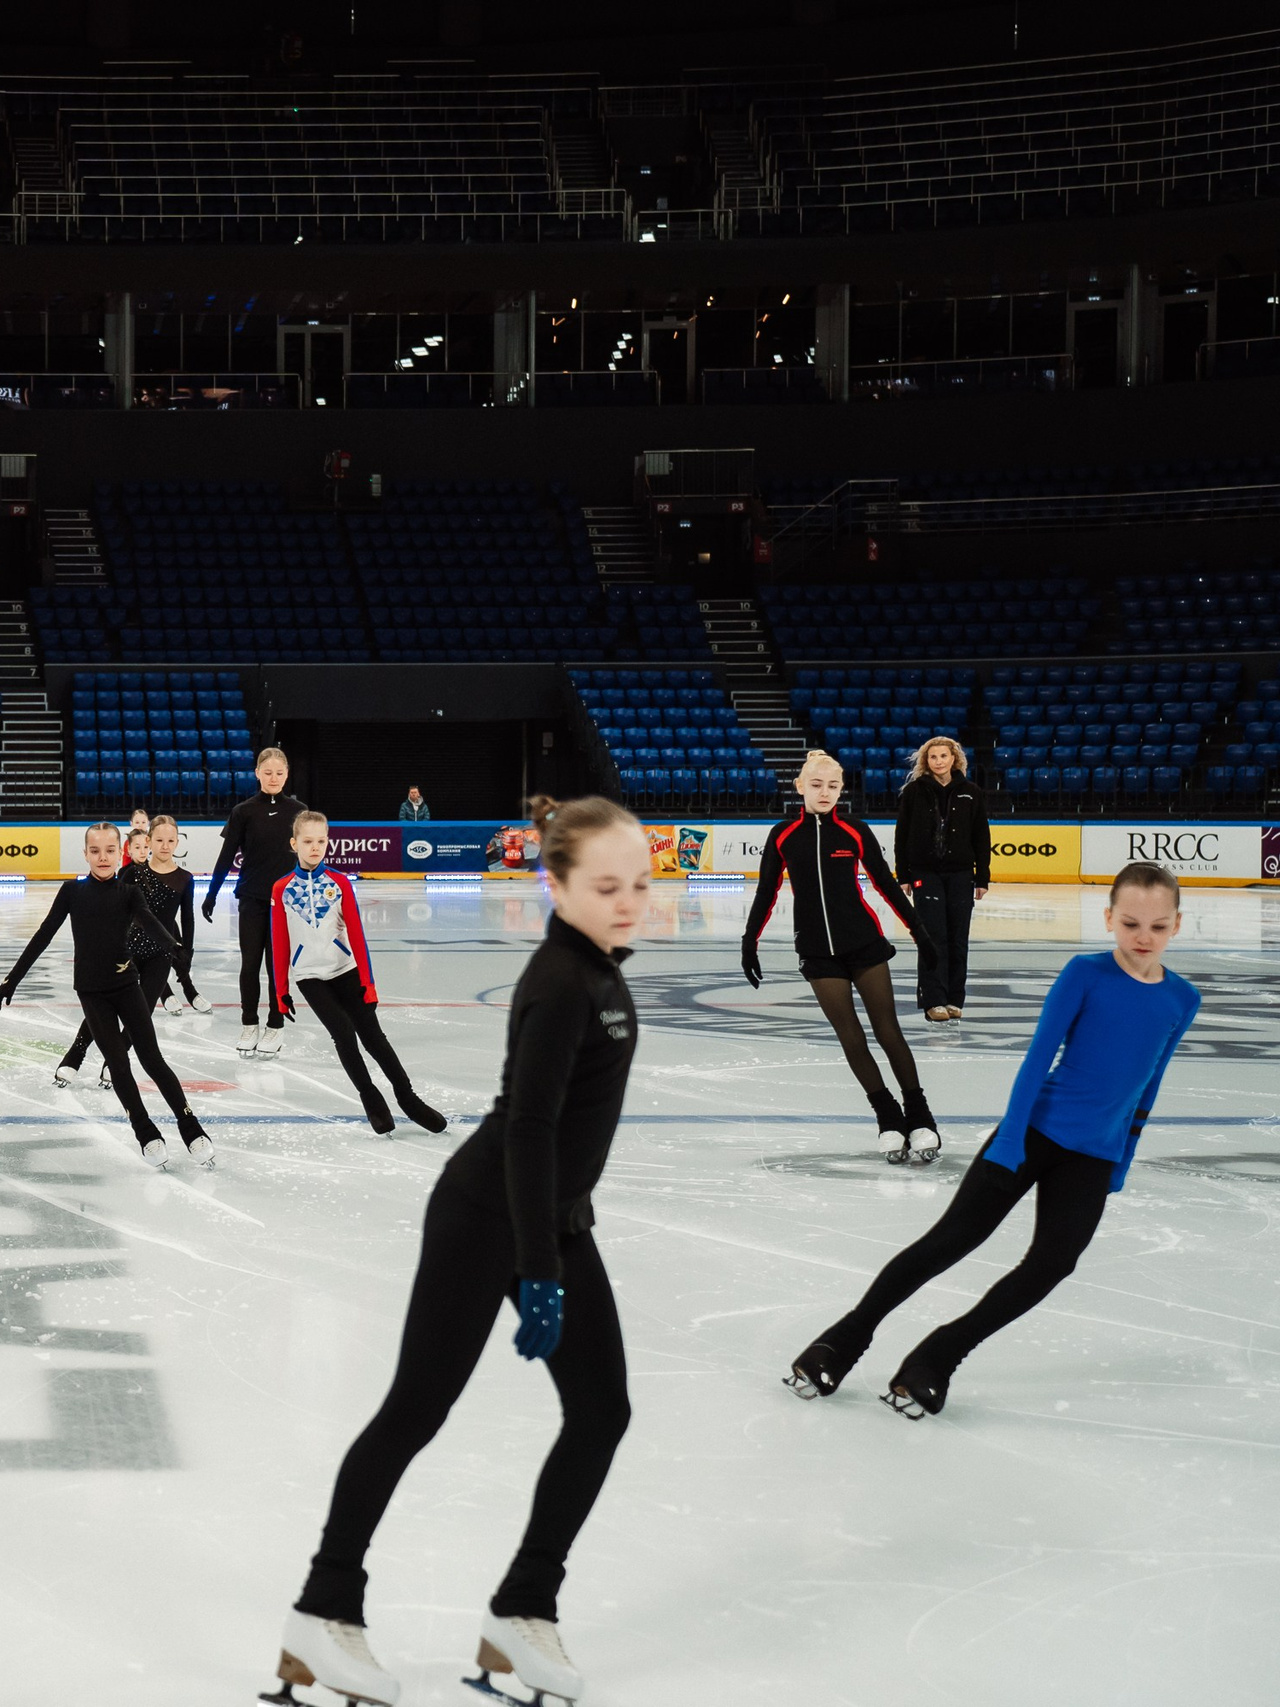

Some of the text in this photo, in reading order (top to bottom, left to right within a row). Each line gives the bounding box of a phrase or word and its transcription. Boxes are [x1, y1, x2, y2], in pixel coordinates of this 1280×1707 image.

[13, 506, 26, 515] P2
[657, 503, 670, 512] P2
[731, 502, 744, 512] P3
[93, 566, 102, 574] 12
[596, 564, 606, 573] 12
[11, 604, 22, 612] 10
[699, 602, 709, 611] 10
[740, 602, 751, 610] 10
[20, 624, 27, 633] 9
[704, 622, 712, 630] 9
[750, 621, 758, 630] 9
[24, 646, 32, 655] 8
[711, 644, 718, 652] 8
[757, 643, 764, 652] 8
[30, 668, 36, 676] 7
[765, 665, 772, 674] 7
[328, 838, 391, 856] урист
[738, 841, 766, 856] Tea
[990, 843, 1057, 857] КОФФ
[1126, 832, 1219, 861] RRCC
[323, 857, 362, 865] агазин
[1189, 863, 1218, 871] CLUB
